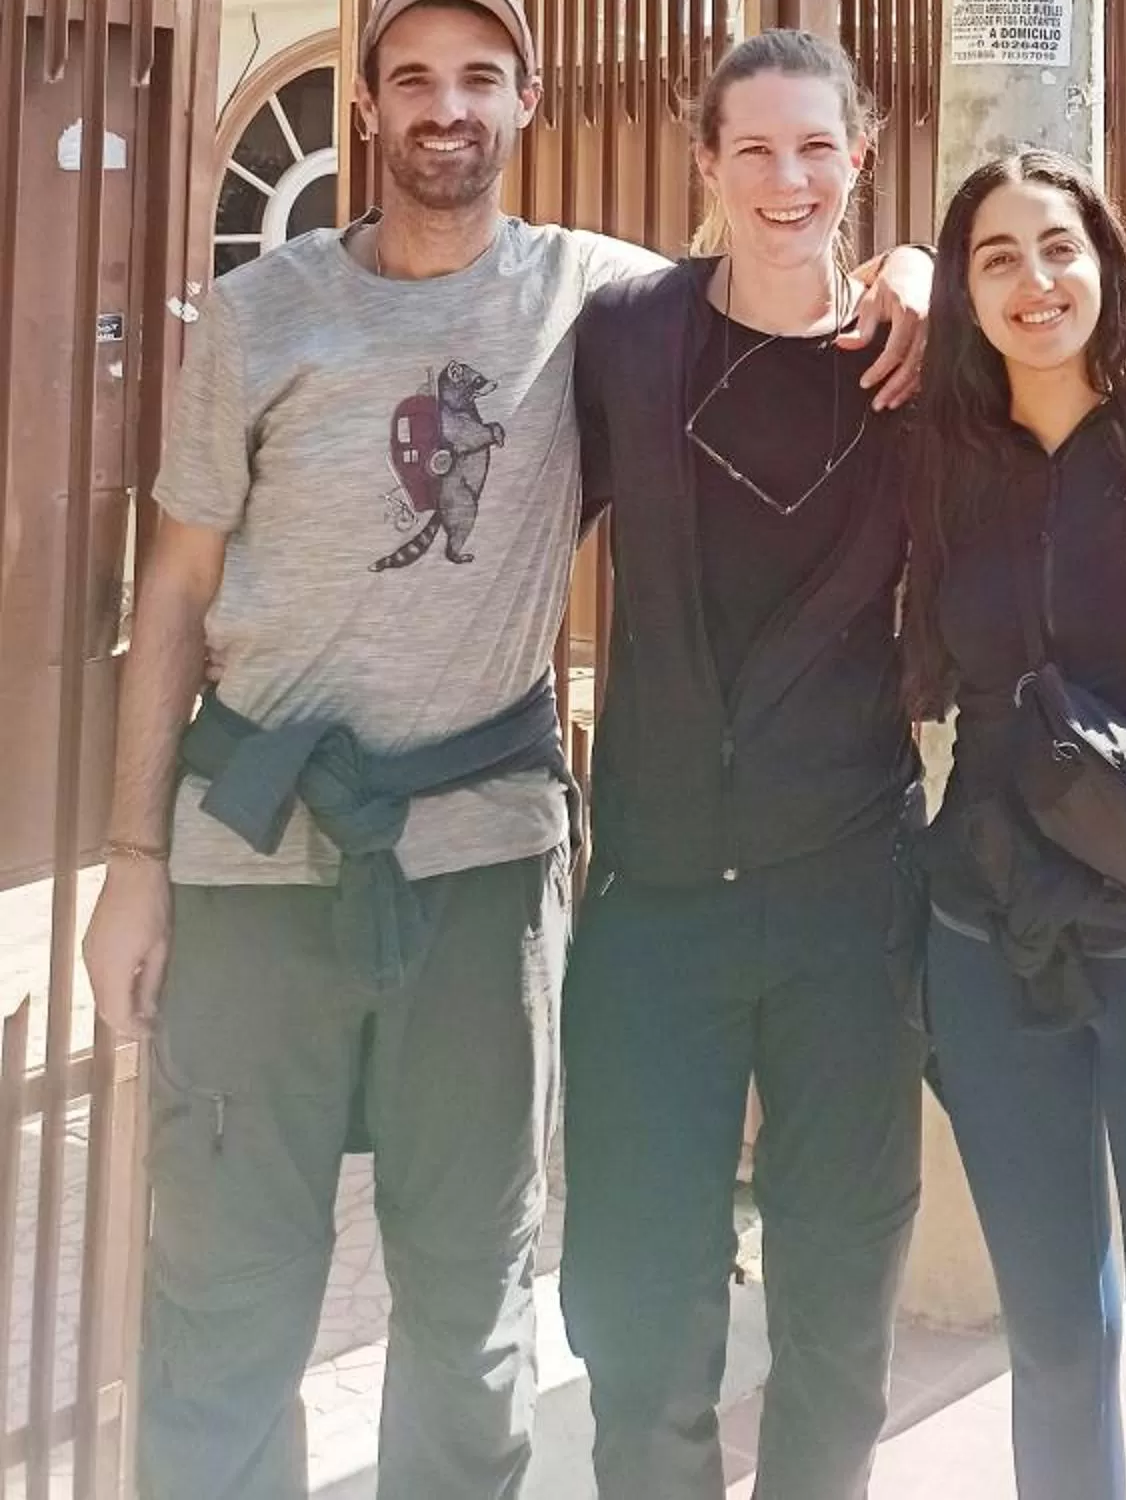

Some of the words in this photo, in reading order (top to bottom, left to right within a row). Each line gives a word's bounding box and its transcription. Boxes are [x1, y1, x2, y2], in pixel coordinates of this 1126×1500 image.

[989, 28, 997, 38] A
[1001, 28, 1062, 40] DOMICILIO
[991, 41, 1059, 50] 4026402
